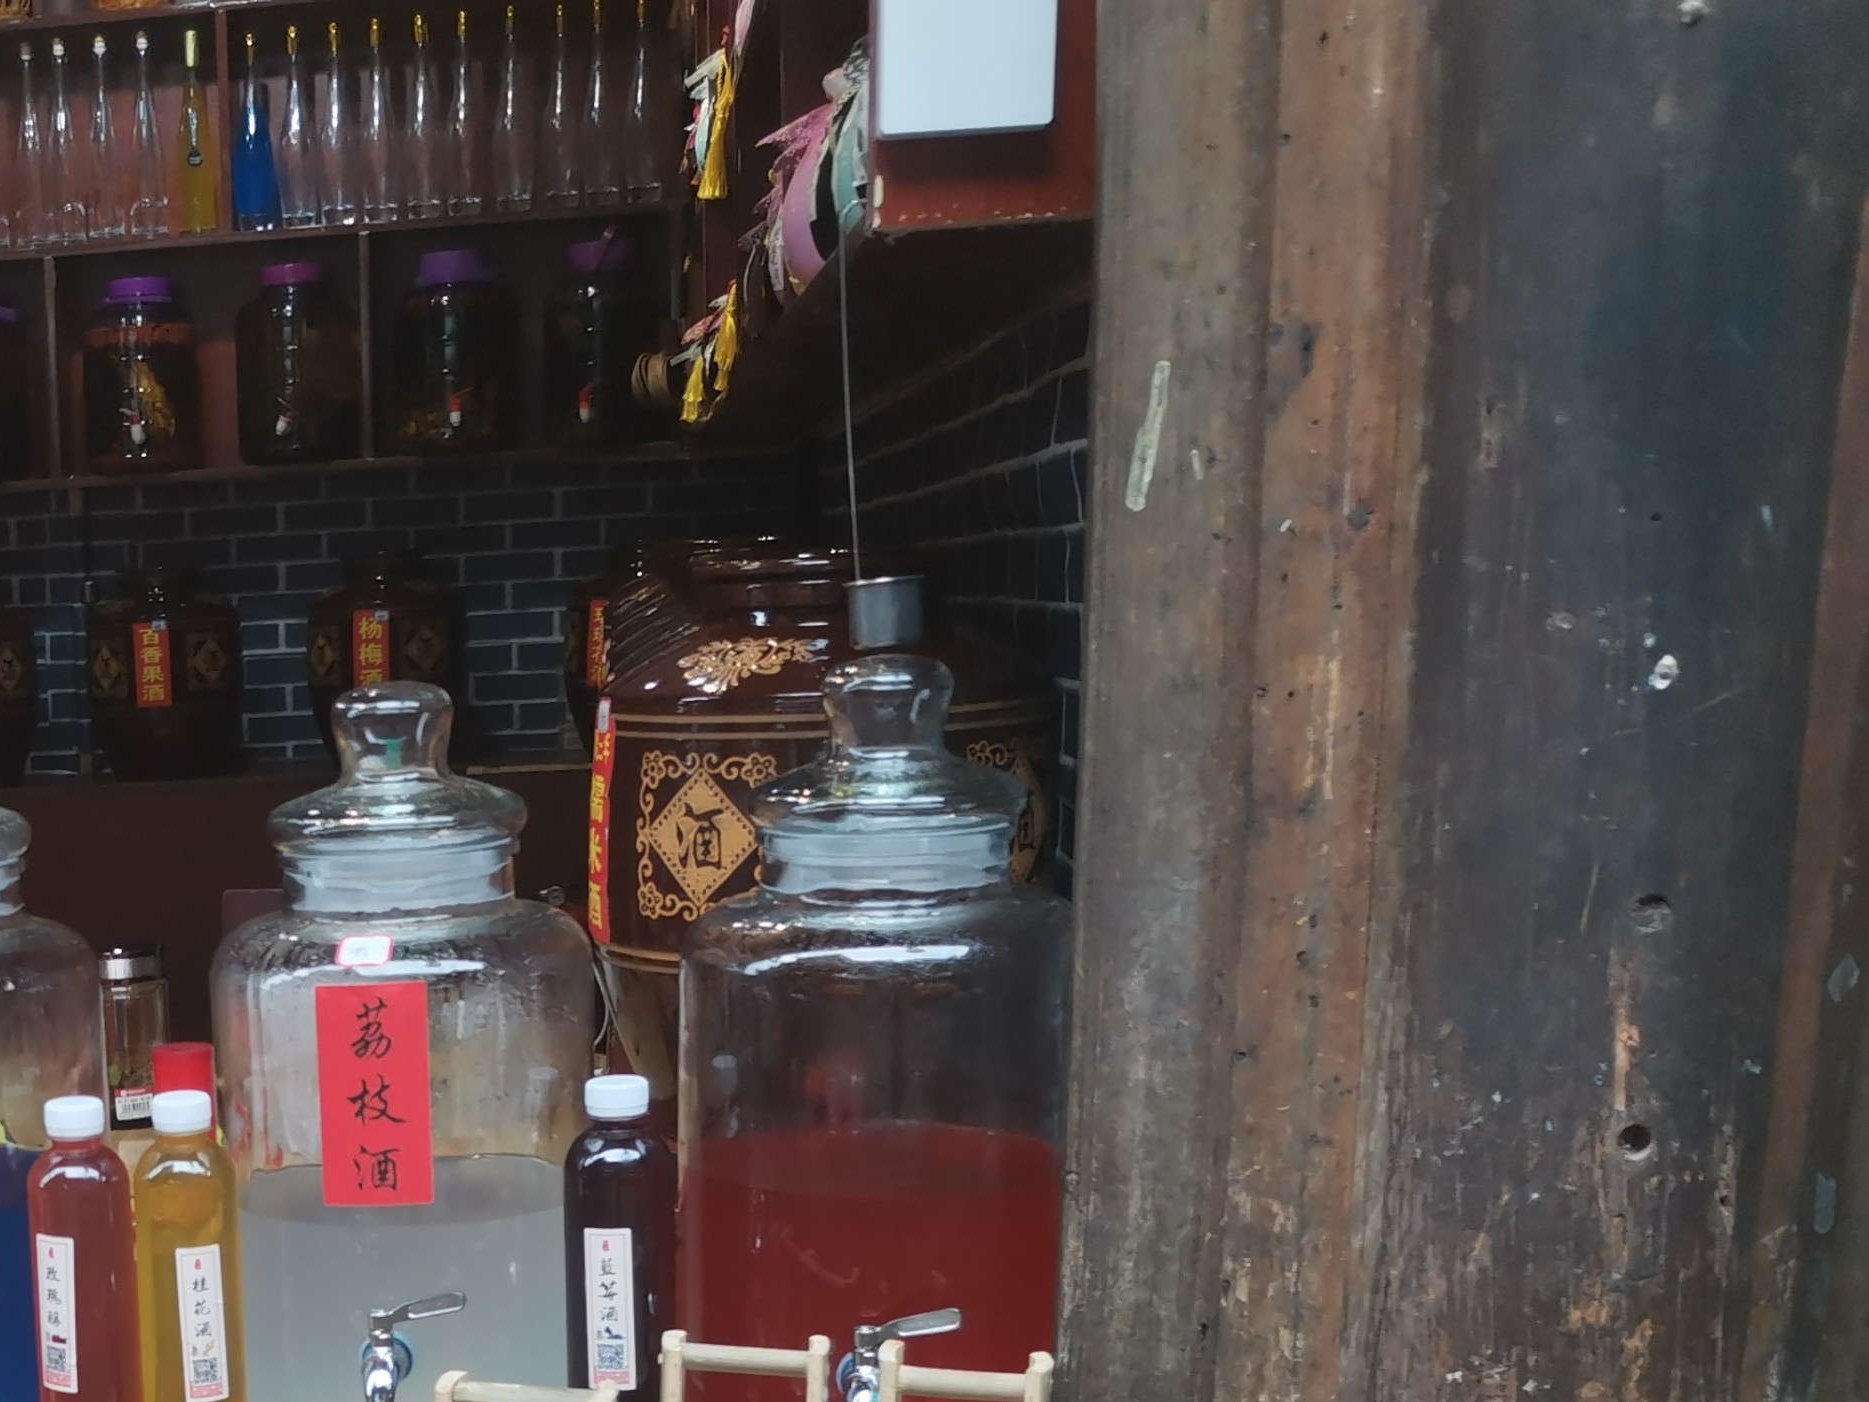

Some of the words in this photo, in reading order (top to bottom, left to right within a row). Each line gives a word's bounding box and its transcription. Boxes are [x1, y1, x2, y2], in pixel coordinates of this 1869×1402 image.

[139, 629, 164, 702] 百香果酒
[676, 803, 723, 870] 酒
[346, 998, 407, 1192] 荔枝酒
